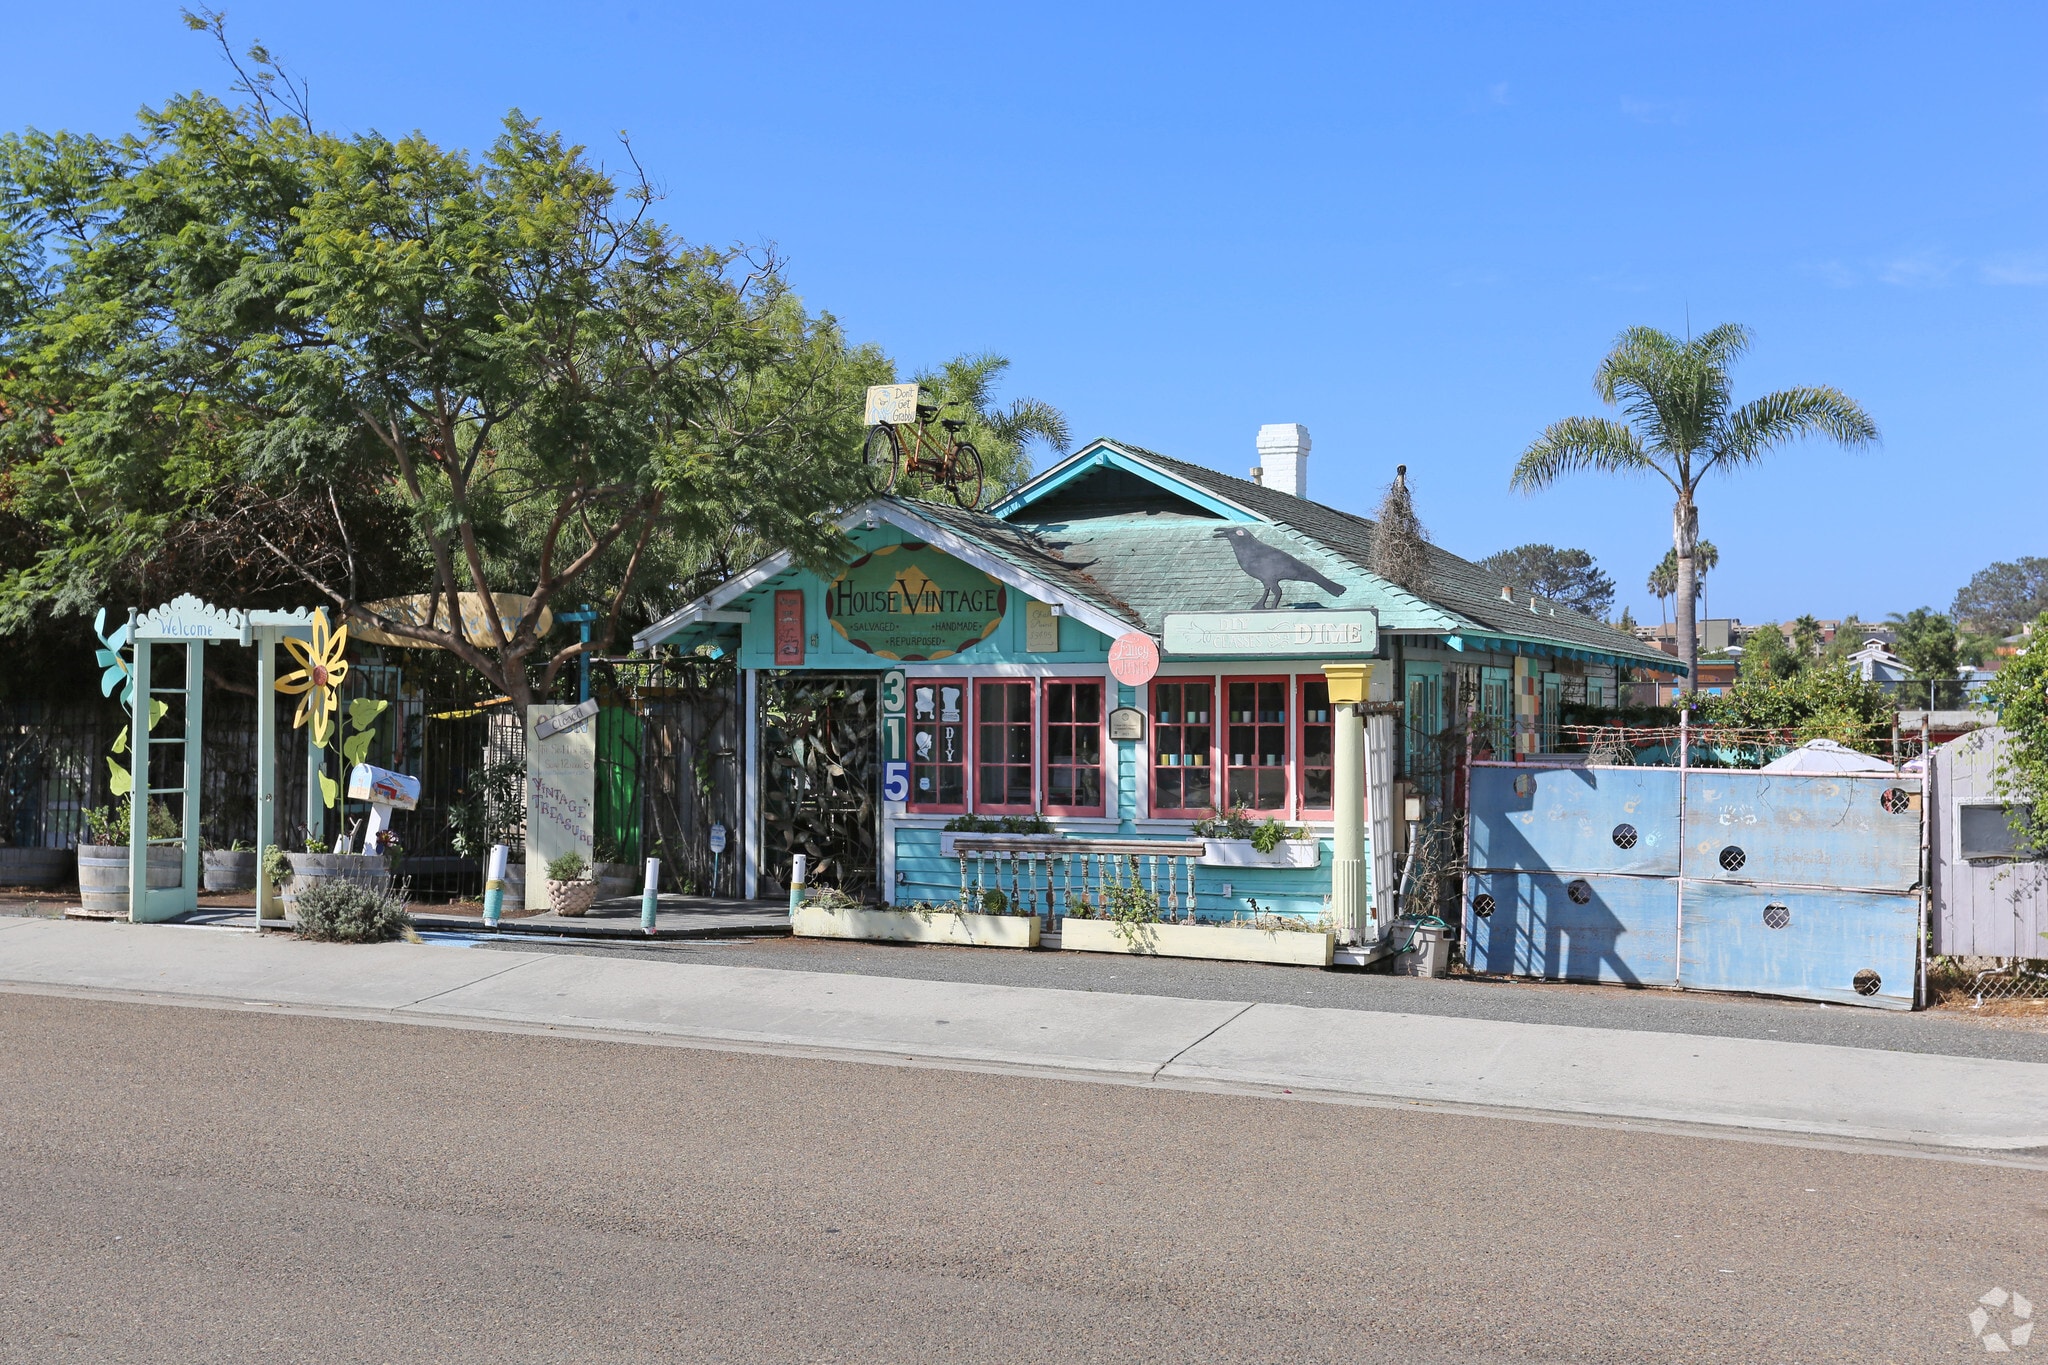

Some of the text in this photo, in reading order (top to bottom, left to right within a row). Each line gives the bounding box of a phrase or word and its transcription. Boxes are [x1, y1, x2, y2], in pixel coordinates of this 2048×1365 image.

[898, 399, 911, 409] Get
[892, 409, 915, 423] Grabby
[897, 578, 998, 616] VINTAGE
[158, 616, 213, 636] Welcome
[852, 621, 978, 632] SALVAGED HANDMADE
[1219, 617, 1250, 631] DIY
[889, 636, 942, 646] REPURPOSED
[1212, 632, 1263, 649] CLASSES
[1293, 623, 1362, 645] DIME
[1112, 640, 1149, 661] Fancy
[551, 708, 584, 729] Closed
[945, 727, 955, 762] DIY
